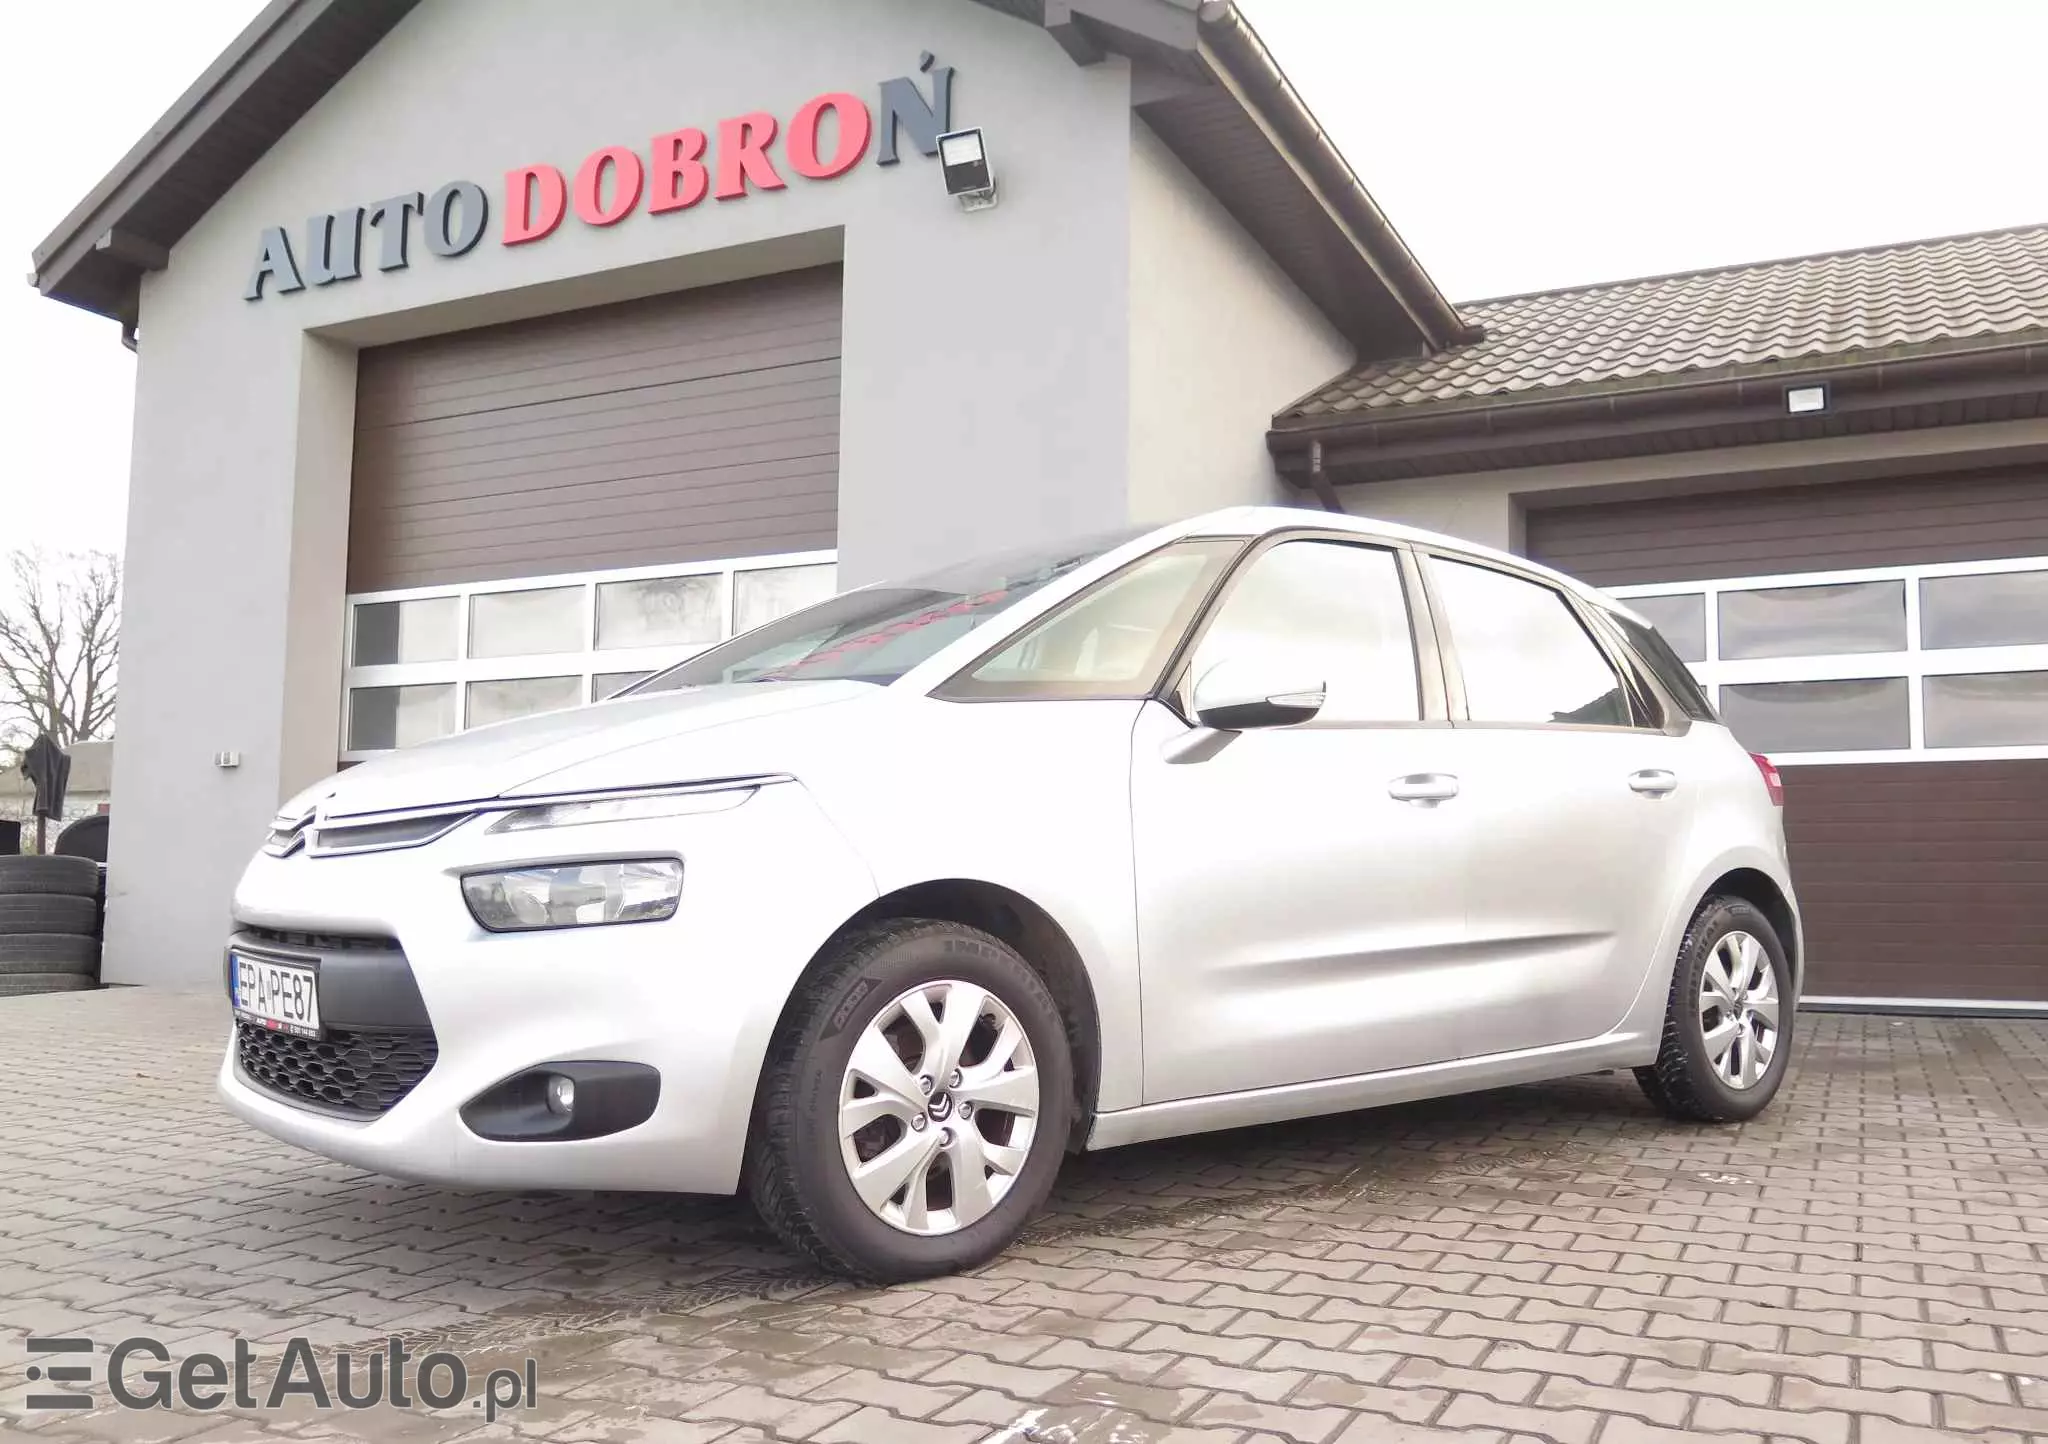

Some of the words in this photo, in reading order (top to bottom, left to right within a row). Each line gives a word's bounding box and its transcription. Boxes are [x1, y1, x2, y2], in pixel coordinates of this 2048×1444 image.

[243, 179, 489, 301] AUTO
[501, 52, 955, 247] DOBROŃ
[239, 962, 267, 1012] EPA
[270, 969, 314, 1023] PE87
